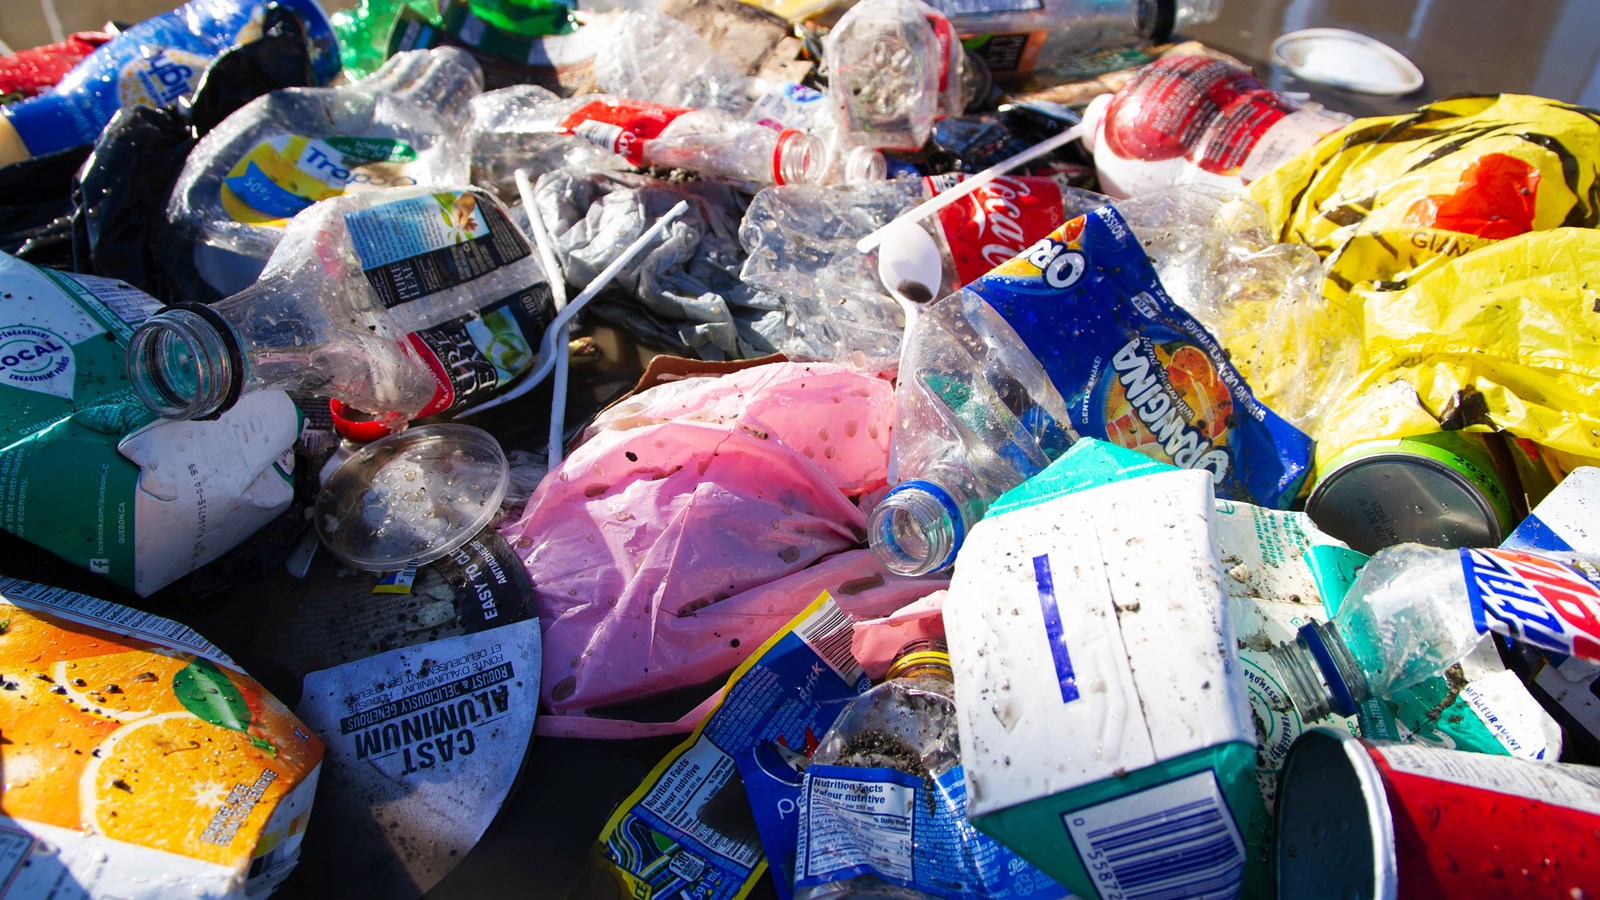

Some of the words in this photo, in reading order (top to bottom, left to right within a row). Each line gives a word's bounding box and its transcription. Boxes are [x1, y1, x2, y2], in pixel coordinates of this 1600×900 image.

[243, 177, 272, 202] 50%
[391, 263, 410, 299] PURE
[1183, 319, 1215, 353] BEVERAGE
[9, 369, 56, 382] ENGAGEMENT
[1082, 390, 1094, 425] GENTLY
[1088, 356, 1103, 389] SHAKE!
[1112, 337, 1230, 485] ORANGINA
[1177, 400, 1195, 420] with
[2, 449, 15, 473] dairy
[10, 448, 25, 502] contributes
[18, 477, 29, 521] economy.
[465, 563, 483, 582] TO
[474, 583, 499, 621] EASY
[473, 653, 504, 671] FONTE
[491, 643, 502, 655] ET
[402, 665, 470, 695] D'ALUMINIUM
[471, 664, 508, 690] ROBUST
[1243, 668, 1282, 706] PROMESSE
[348, 692, 393, 713] ROBUSTE
[401, 683, 461, 713] DELICIOUSLY
[347, 705, 398, 731] GENEROUS
[354, 684, 509, 760] ALUMINUM
[1370, 697, 1388, 738] TIELLEMENT
[1464, 686, 1498, 724] MEILLEUR
[1493, 723, 1522, 752] AVANT
[402, 728, 476, 776] CAST
[645, 775, 674, 809] Nutrition
[671, 758, 690, 781] Facts
[712, 768, 723, 783] Daily
[720, 757, 732, 771] Value
[233, 767, 279, 820] CONCENTRATE
[654, 790, 678, 816] Valeur
[675, 763, 701, 796] nutritive
[813, 778, 857, 792] Nutrition
[859, 782, 884, 793] Facts
[813, 787, 844, 801] Valeur
[845, 793, 886, 804] nutritive
[199, 804, 233, 843] ORANGE
[880, 817, 895, 825] Daily
[1073, 818, 1085, 827] 0
[671, 852, 691, 871] 130
[692, 881, 711, 900] 591
[707, 867, 721, 883] mL
